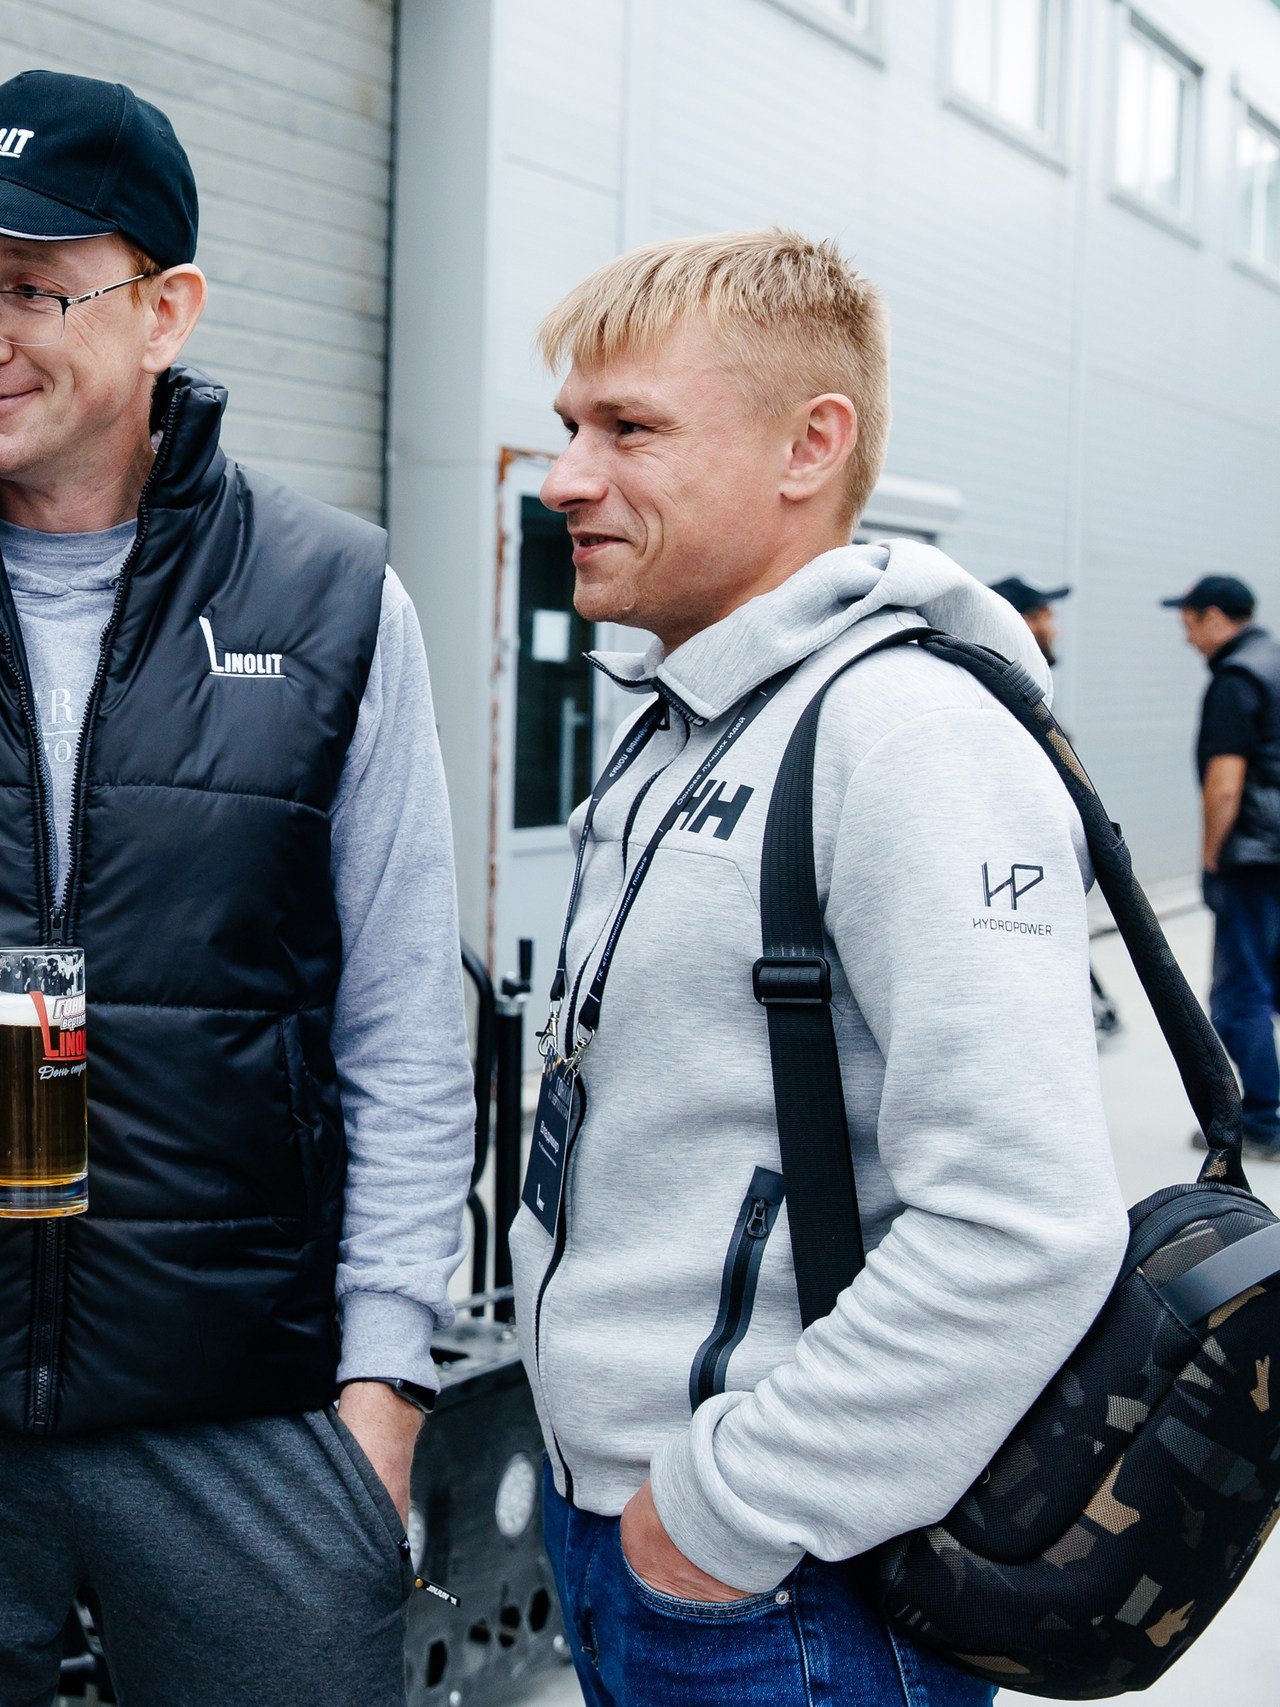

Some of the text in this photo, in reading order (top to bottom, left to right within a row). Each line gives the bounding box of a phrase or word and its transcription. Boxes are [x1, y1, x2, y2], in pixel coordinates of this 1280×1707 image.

[199, 615, 286, 678] LINOLIT
[676, 716, 746, 806] Основа лучших идей
[596, 856, 648, 982] ГК «Промышленные полы»
[972, 917, 1053, 937] HYDROPOWER
